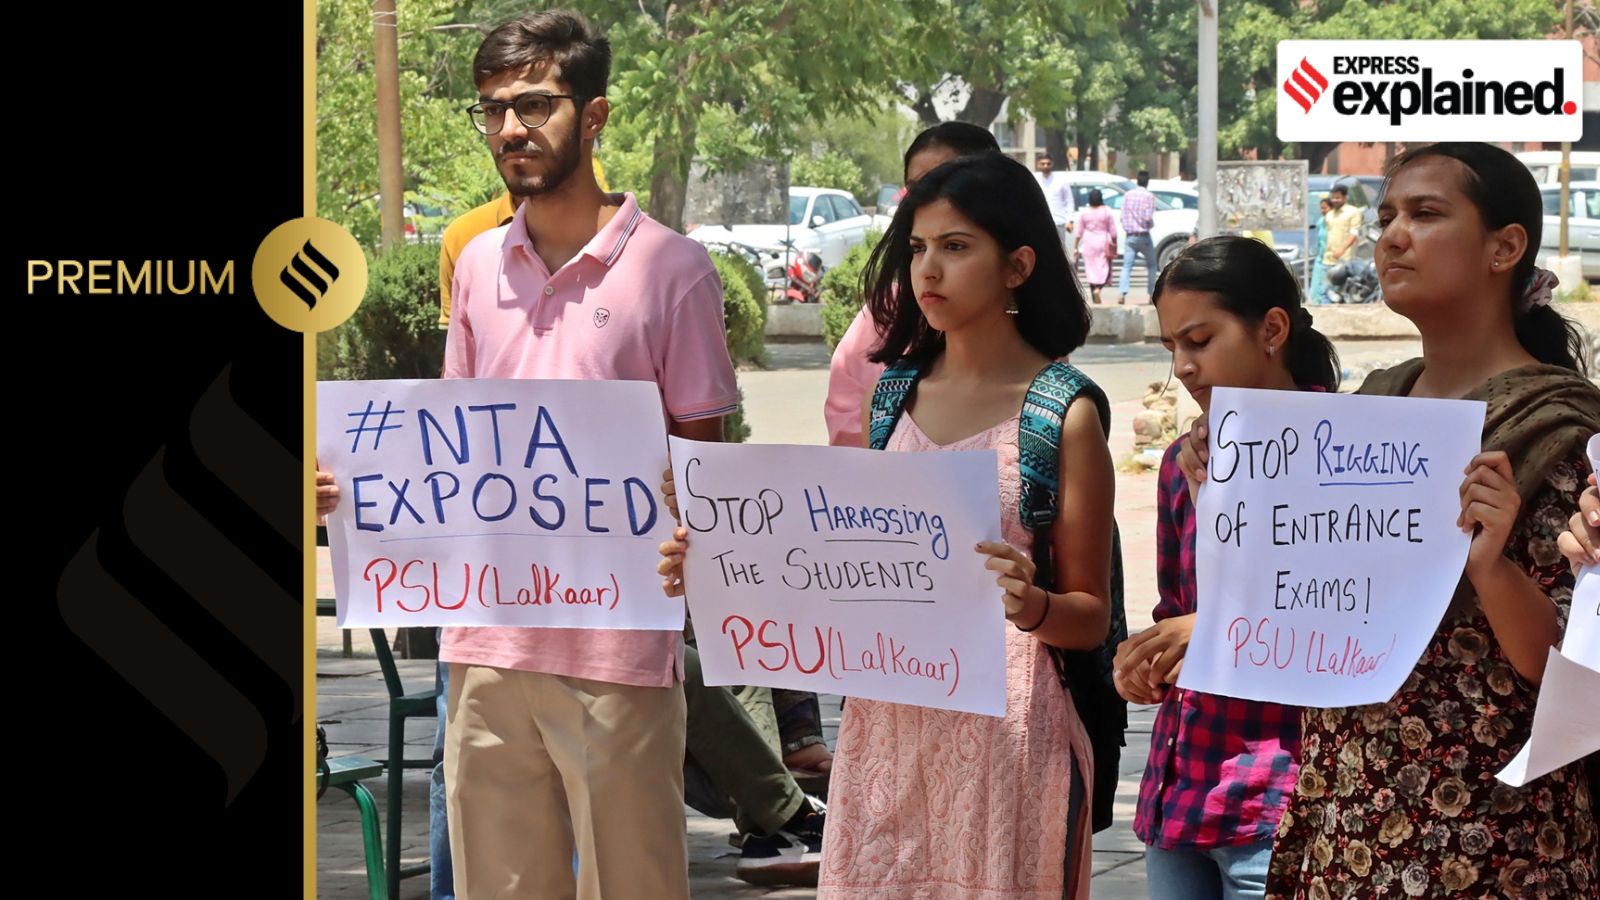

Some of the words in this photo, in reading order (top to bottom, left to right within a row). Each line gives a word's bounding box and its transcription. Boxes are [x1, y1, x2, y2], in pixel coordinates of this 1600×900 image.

[1313, 419, 1430, 478] RIGGING
[352, 471, 658, 536] EXPOSED
[1272, 503, 1423, 546] ENTRANCE
[711, 550, 765, 587] THE
[1274, 570, 1371, 625] EXAMS!
[1228, 617, 1295, 670] PSU
